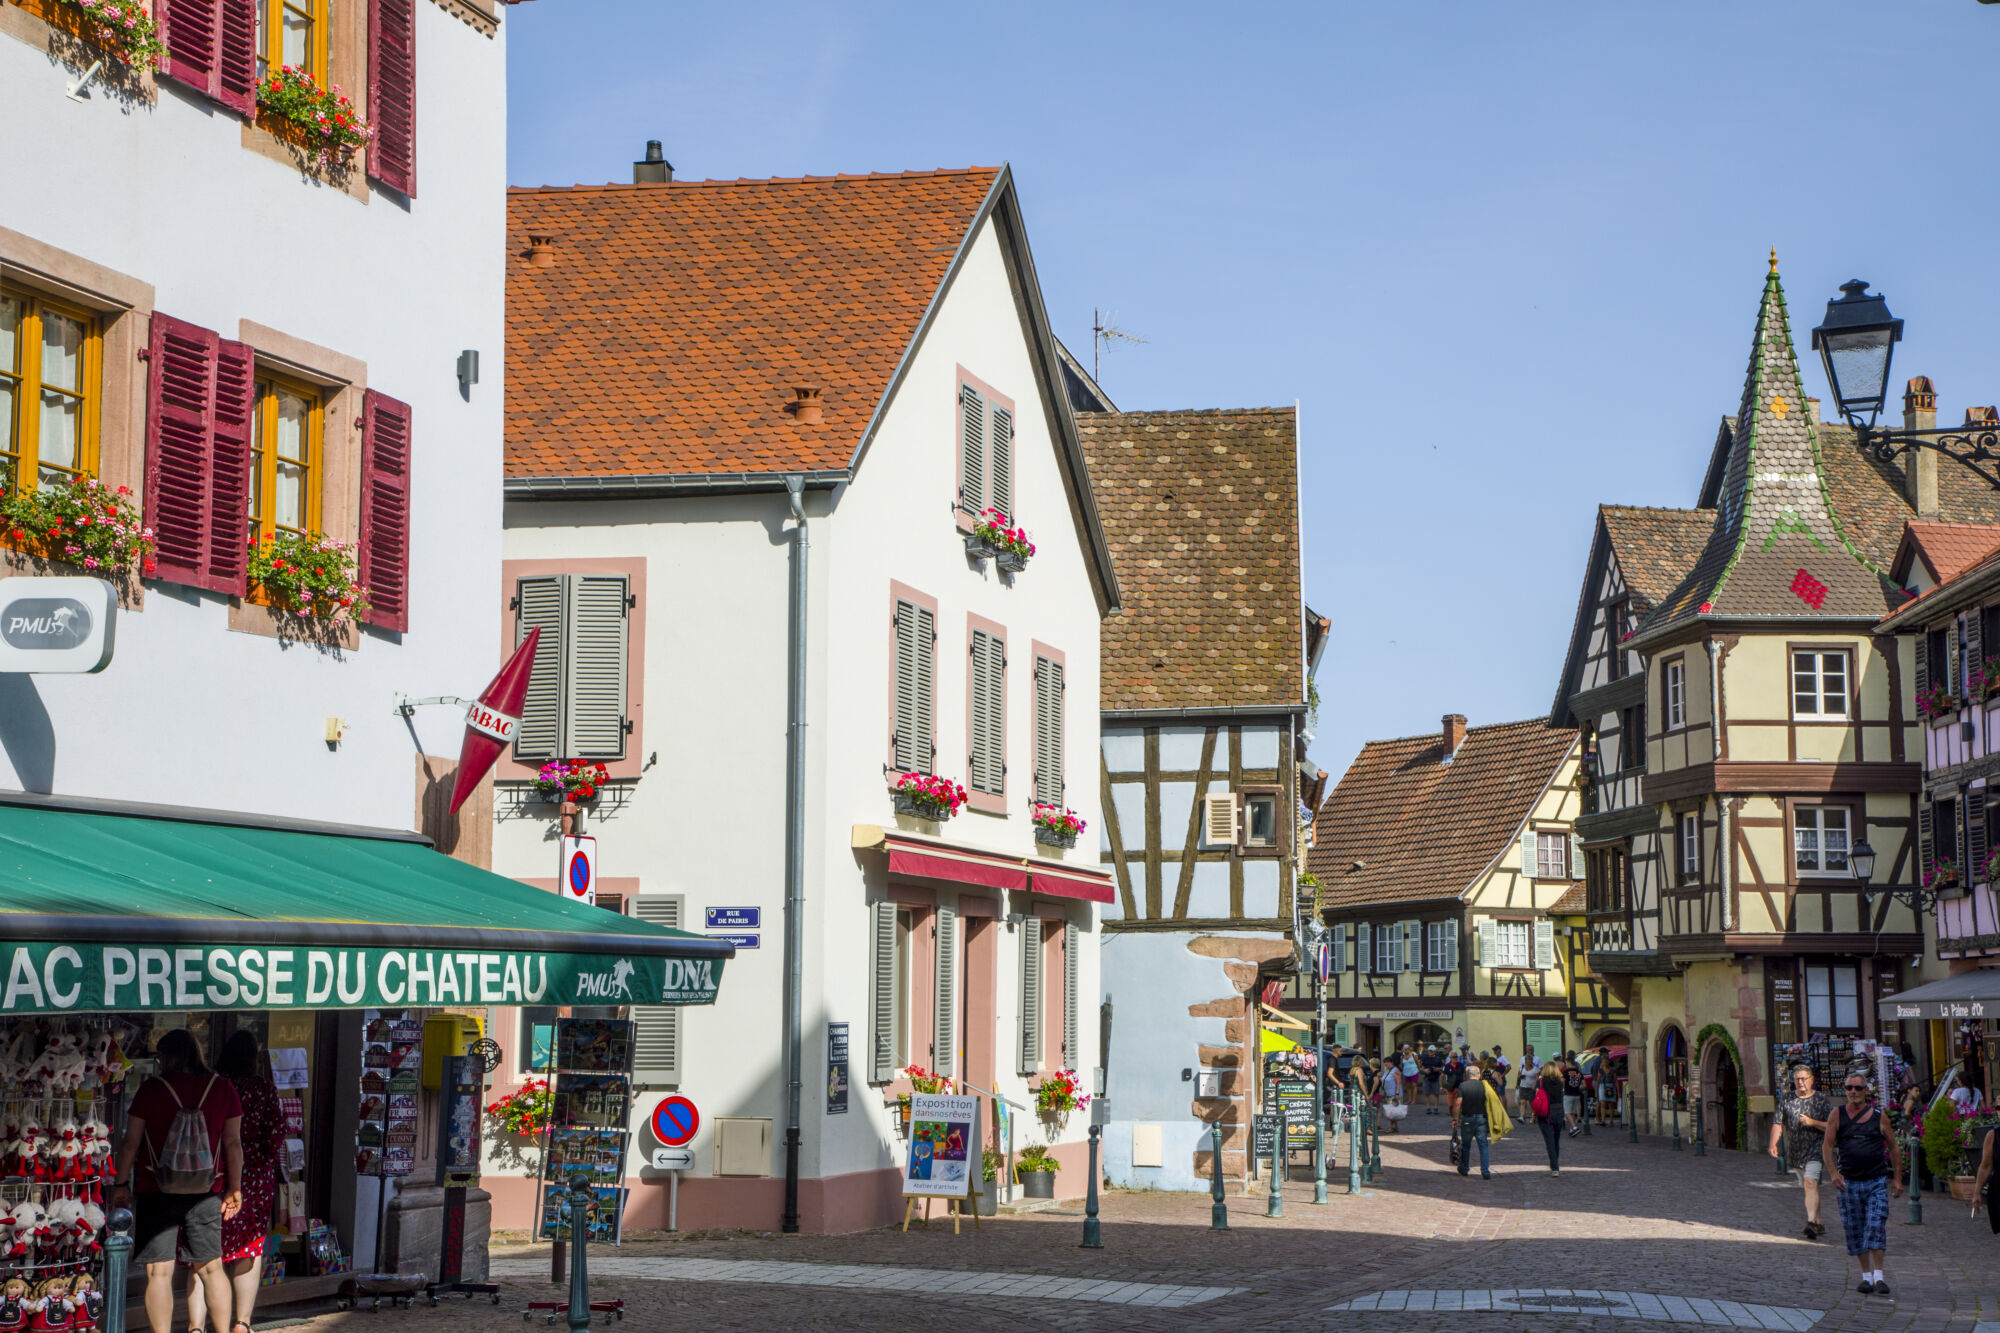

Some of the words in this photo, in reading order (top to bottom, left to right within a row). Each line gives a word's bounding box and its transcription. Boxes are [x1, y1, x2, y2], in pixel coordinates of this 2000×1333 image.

[9, 617, 52, 634] PMU
[0, 945, 83, 1008] AC
[103, 947, 294, 1006] PRESSE
[306, 951, 366, 1005] DU
[377, 950, 547, 1004] CHATEAU
[663, 959, 717, 990] DNA
[576, 973, 613, 997] PMU
[1897, 1004, 1921, 1017] Brasserie
[1940, 1003, 1949, 1017] La
[1951, 1003, 1969, 1017] Palme
[1972, 1002, 1984, 1016] d'Or
[916, 1097, 972, 1109] Exposition
